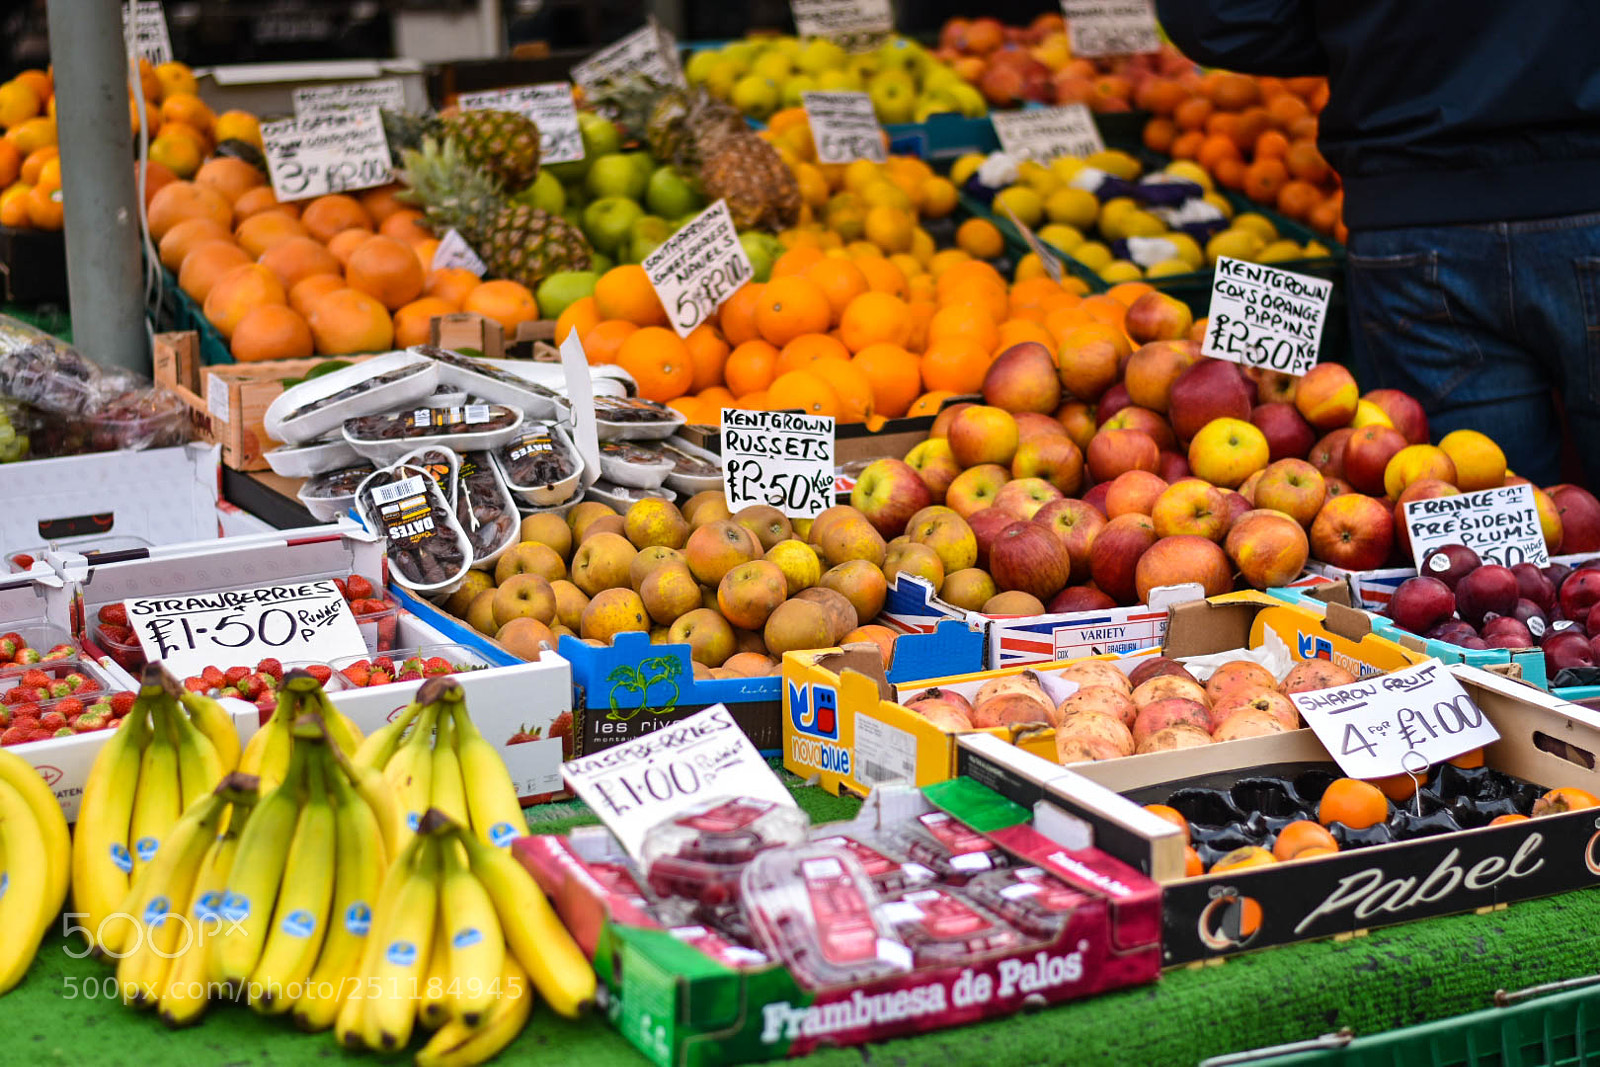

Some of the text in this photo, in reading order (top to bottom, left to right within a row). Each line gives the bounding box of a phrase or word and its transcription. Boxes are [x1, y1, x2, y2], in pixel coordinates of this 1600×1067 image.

[676, 235, 735, 284] NAVELS
[1245, 305, 1316, 340] PIPPINS
[511, 443, 553, 461] DATES
[726, 430, 829, 461] RUSSETS
[727, 460, 811, 510] £2.50
[1409, 486, 1526, 515] FRANCE CAT
[389, 516, 435, 539] DATES
[1411, 508, 1535, 538] PRESIDENT
[1460, 523, 1538, 546] PLUMS
[131, 581, 336, 615] STRAWBERRIES
[145, 599, 343, 660] £1.50 PUNNET
[1080, 626, 1126, 641] VARIETY
[1057, 649, 1069, 660] COX
[1299, 665, 1437, 712] SHARON FRUIT
[594, 720, 628, 734] les
[1341, 723, 1378, 758] 4
[1397, 694, 1483, 749] £1.00
[565, 711, 733, 777] RASPBERRIES
[792, 735, 851, 777] novablue
[591, 761, 701, 816] £1.00
[1294, 832, 1545, 935] Pabel
[761, 950, 1085, 1044] Frambuesa de Palos
